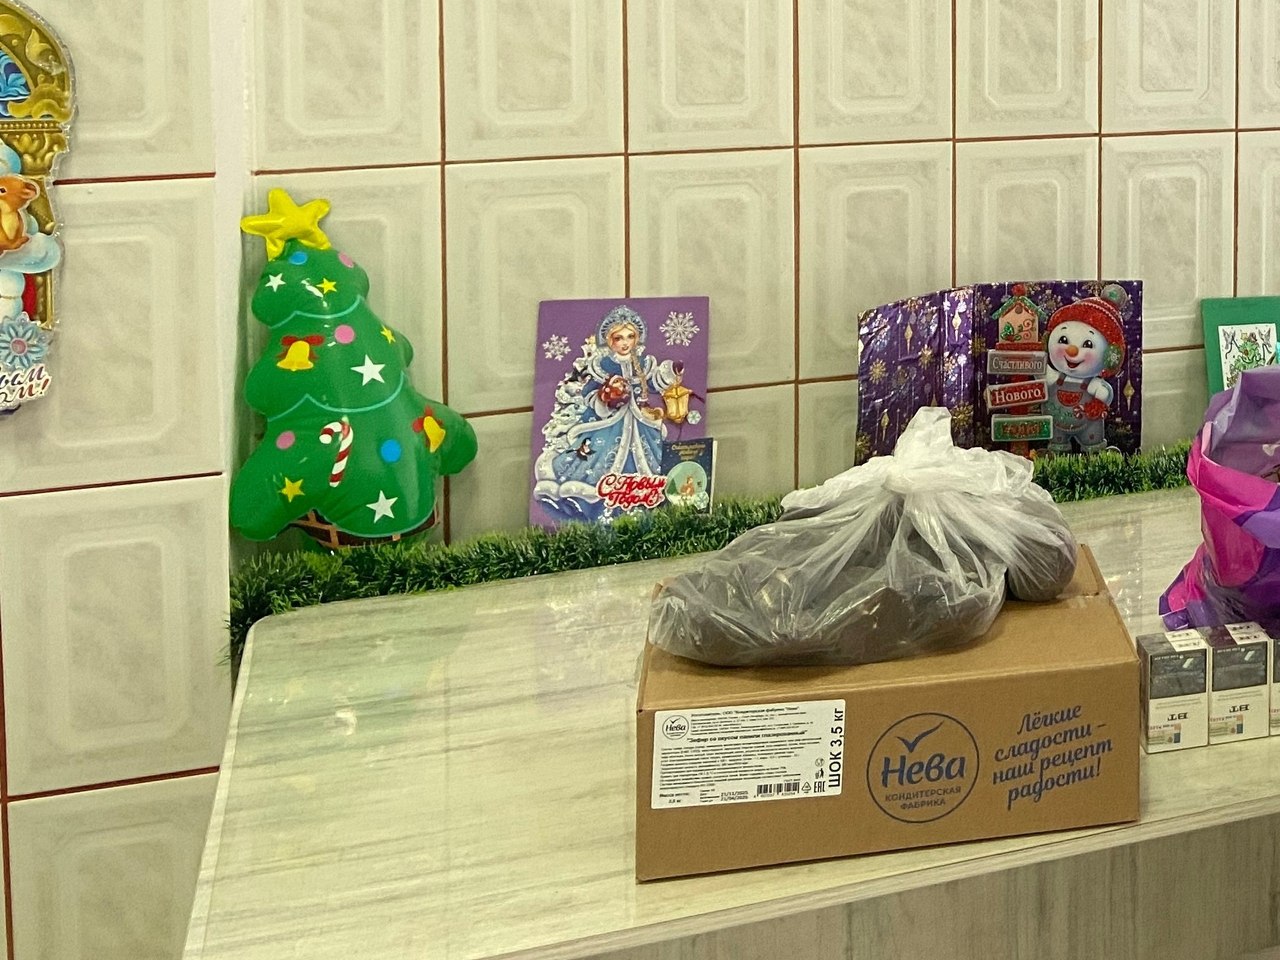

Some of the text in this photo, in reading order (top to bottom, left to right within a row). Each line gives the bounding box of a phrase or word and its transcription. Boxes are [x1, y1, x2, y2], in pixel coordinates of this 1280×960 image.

[992, 357, 1042, 369] Счастливого
[995, 388, 1042, 403] Нового
[665, 724, 686, 732] Нева
[1017, 705, 1082, 735] Лёгкие
[829, 726, 845, 747] 3,5
[994, 723, 1092, 762] сладости
[828, 751, 842, 788] ШОК
[881, 752, 966, 788] Нева
[992, 738, 1113, 785] наш рецепт
[885, 785, 962, 802] КОНДИТЕРСКАЯ
[1007, 757, 1101, 811] радости!
[900, 798, 946, 810] ФАБРИКА
